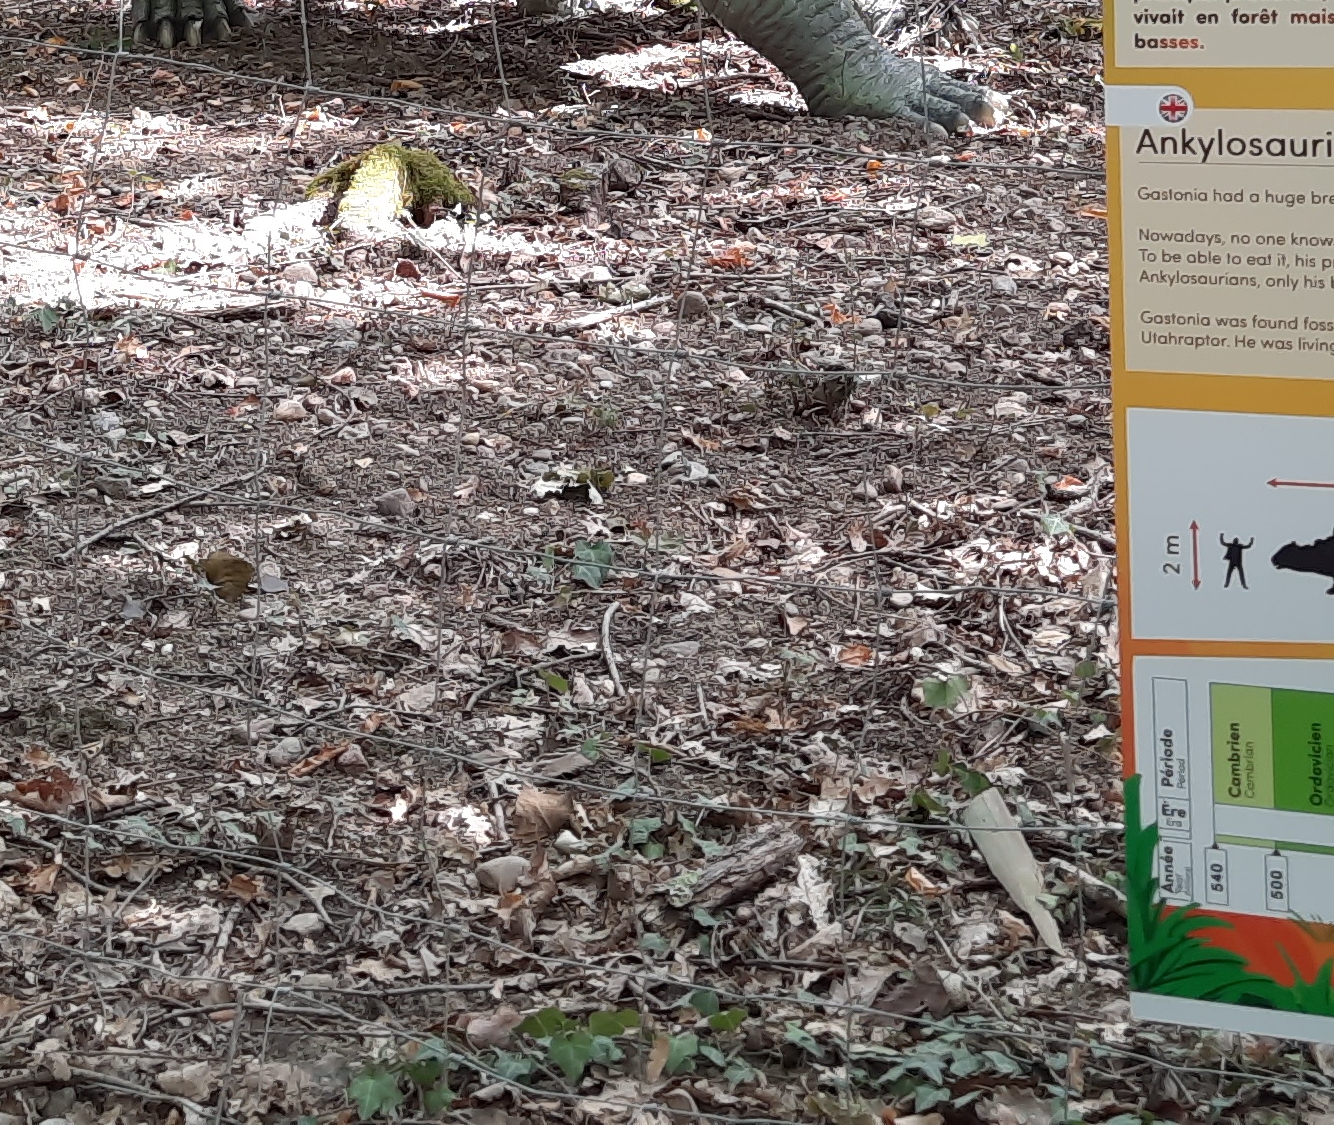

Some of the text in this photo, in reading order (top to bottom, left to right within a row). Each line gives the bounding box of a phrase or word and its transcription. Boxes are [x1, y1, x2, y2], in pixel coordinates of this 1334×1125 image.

[1133, 8, 1185, 25] vivait
[1196, 13, 1219, 25] en
[1231, 8, 1278, 25] forêt
[1134, 33, 1204, 49] basses.
[1137, 186, 1208, 202] Gastonia
[1213, 188, 1244, 203] had
[1249, 193, 1260, 203] a
[1265, 189, 1306, 208] huge
[1140, 310, 1211, 327] Gastonia
[1215, 317, 1248, 328] was
[1251, 314, 1298, 330] found
[1163, 535, 1181, 575] 2 m
[1159, 728, 1175, 788] Période
[1227, 722, 1242, 798] Cambrien
[1307, 722, 1323, 806] Ordovicien
[1159, 845, 1174, 894] Année
[1210, 862, 1224, 893] 540
[1270, 869, 1284, 900] 500
